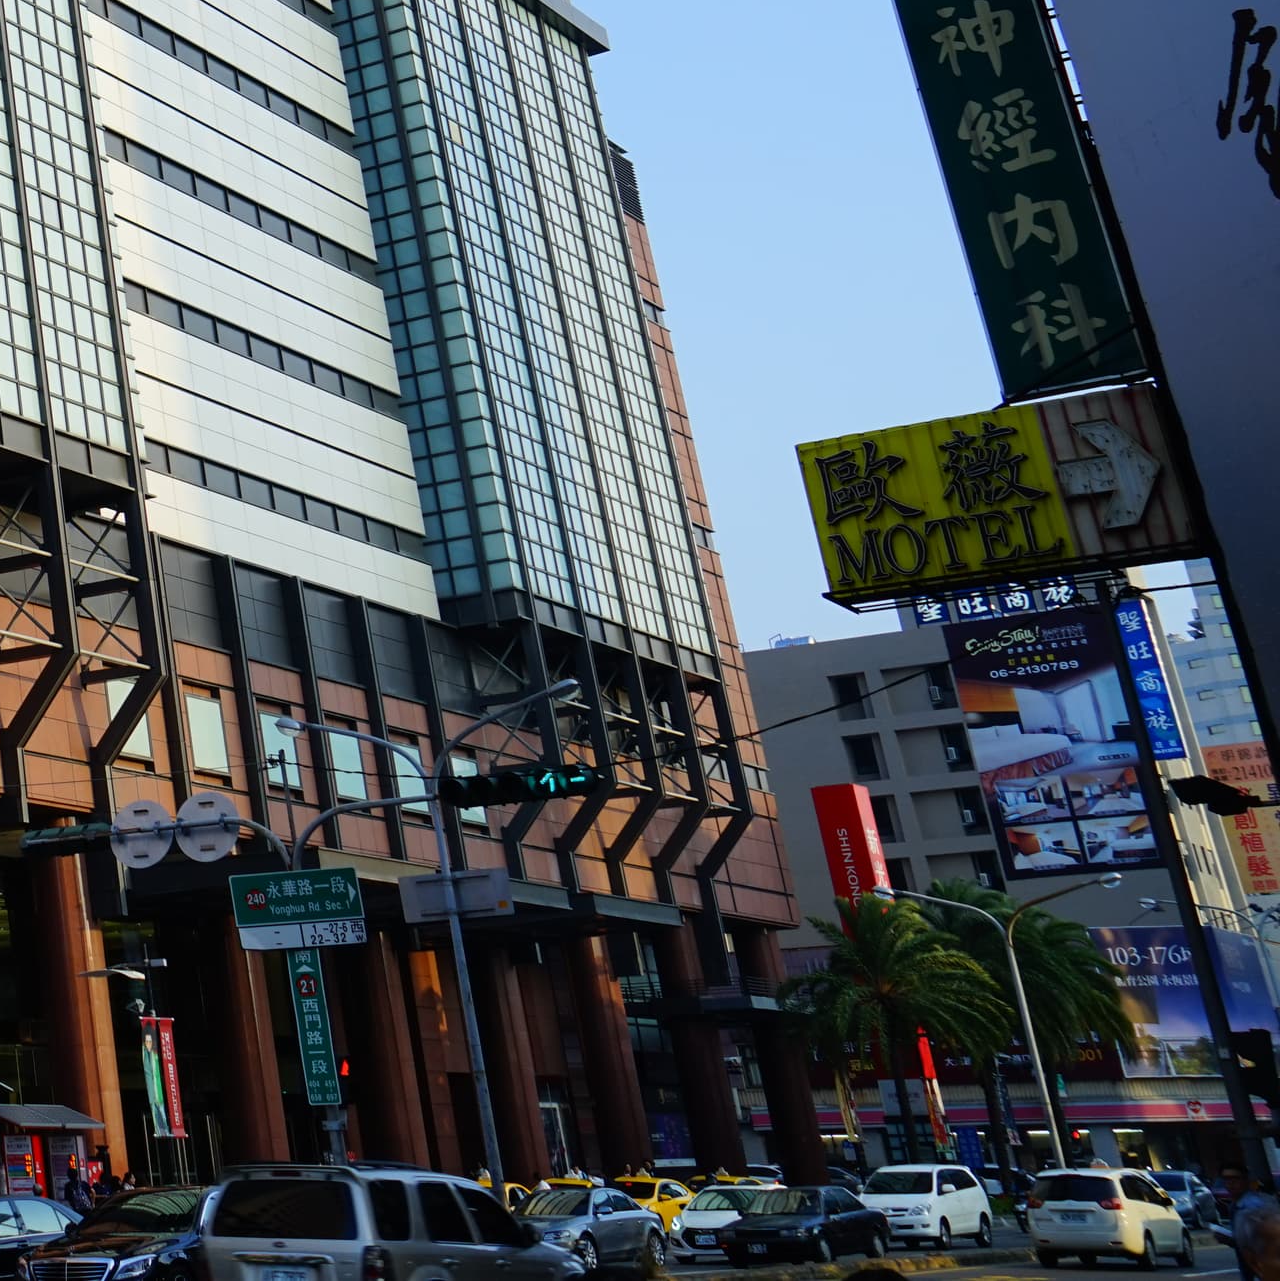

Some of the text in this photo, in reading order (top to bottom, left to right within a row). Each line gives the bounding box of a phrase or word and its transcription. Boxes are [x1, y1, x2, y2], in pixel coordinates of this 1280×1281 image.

[815, 421, 1051, 525] 歐薇
[828, 505, 1066, 585] MOTEL
[989, 659, 1080, 679] 06-2130789
[1116, 611, 1175, 730] 聖旺商旅
[836, 827, 853, 863] SHIN
[1234, 785, 1274, 877] 創植髮
[246, 892, 266, 906] 240
[266, 876, 347, 898] 永華路一段
[269, 902, 306, 916] Yonghua
[350, 920, 364, 933] 西
[299, 979, 315, 993] 21
[301, 998, 328, 1075] 西門路一段
